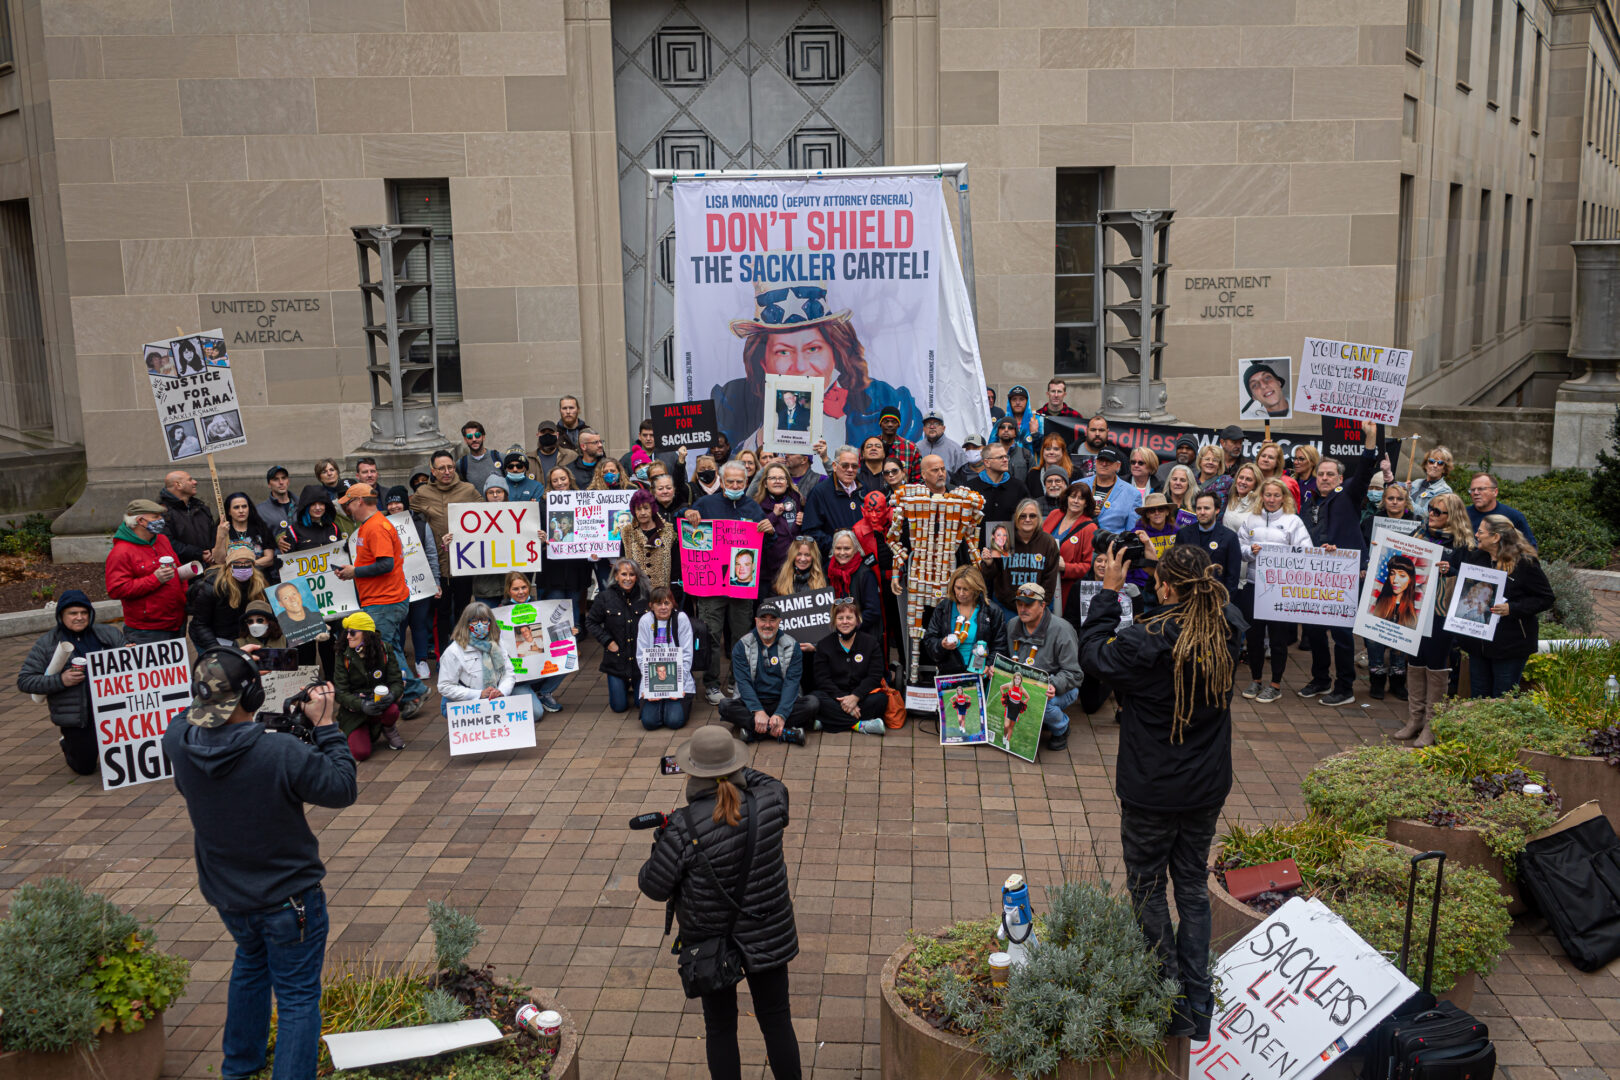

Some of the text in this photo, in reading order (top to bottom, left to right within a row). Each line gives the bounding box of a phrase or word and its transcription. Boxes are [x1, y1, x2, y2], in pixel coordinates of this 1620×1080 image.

[705, 191, 914, 210] LISA MONACO (DEPUTY ATTORNEY GENERAL)
[706, 209, 914, 253] DON'T SHIELD
[690, 250, 930, 284] THE SACKLER CARTEL!
[1184, 275, 1271, 291] DEPARTMENT
[1218, 290, 1238, 304] OF
[211, 298, 321, 315] UNITED STATES
[1199, 304, 1255, 319] JUSTICE
[256, 314, 277, 328] OF
[234, 329, 305, 344] AMERICA
[1311, 340, 1339, 358] YOU
[1386, 349, 1409, 368] BE
[1310, 362, 1352, 379] WORTH
[1353, 365, 1374, 382] $11
[163, 370, 222, 392] JUSTICE
[1309, 378, 1389, 400] AND DECLARE
[183, 387, 211, 401] FOR
[166, 402, 186, 416] MY
[663, 403, 703, 418] JAIL TIME
[675, 418, 694, 430] FOR
[661, 431, 712, 447] SACKLERS
[1344, 430, 1361, 441] FOR
[1329, 443, 1380, 457] SACKLES
[550, 493, 572, 505] DOJ
[575, 491, 595, 500] MAKE
[577, 498, 591, 506] THE
[575, 505, 602, 518] PAY!!!
[460, 508, 528, 534] OXY
[715, 521, 747, 535] Purdue
[552, 543, 563, 554] WE
[567, 543, 588, 554] MISS
[589, 542, 604, 552] YOU
[715, 534, 749, 547] Pharma
[456, 539, 539, 570] KILL$
[693, 563, 711, 571] son
[1258, 556, 1342, 573] FOLLOW THE
[306, 575, 326, 592] DO
[411, 573, 425, 585] AND
[1010, 571, 1039, 586] TECH
[1265, 569, 1358, 590] BLOOD MONEY
[815, 591, 835, 607] ON
[1281, 586, 1345, 602] EVIDENCE
[778, 611, 831, 632] SACKLERS
[90, 641, 184, 677] HARVARD
[93, 665, 188, 698] TAKE DOWN
[126, 691, 161, 713] THAT
[450, 700, 506, 717] TIME TO
[451, 710, 529, 729] HAMMER THE
[1250, 922, 1367, 1027] SACKLERS
[1246, 970, 1300, 1023] LIE
[1213, 986, 1299, 1078] HILDREN
